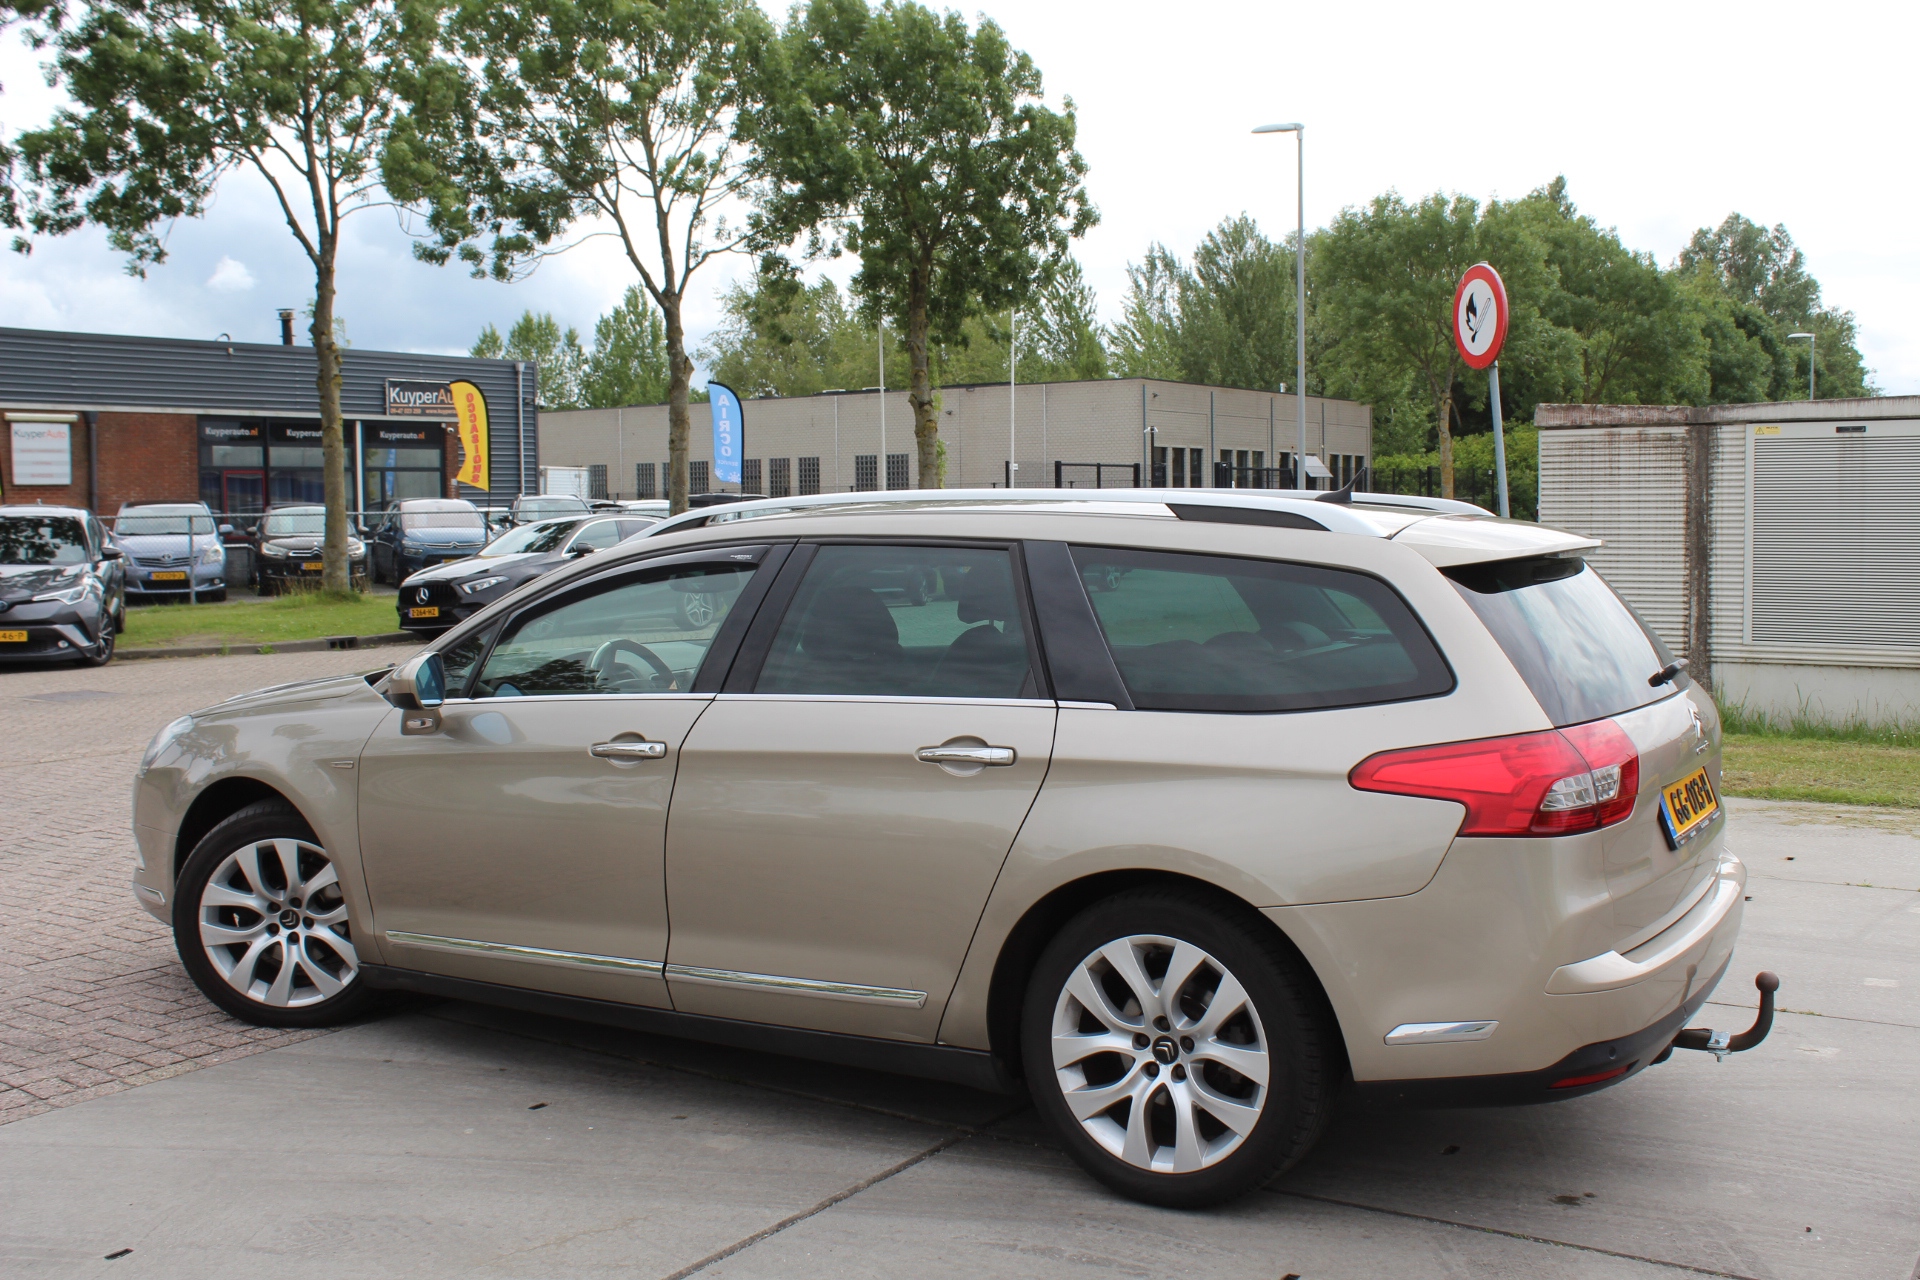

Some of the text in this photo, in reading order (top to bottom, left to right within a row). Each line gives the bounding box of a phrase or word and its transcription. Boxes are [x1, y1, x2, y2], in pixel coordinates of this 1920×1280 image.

[14, 429, 68, 440] KuyperAuto
[205, 427, 259, 438] Kuyperauto.nl
[379, 431, 425, 441] Kuyperauto.nl
[1670, 773, 1713, 825] GG-013-H
